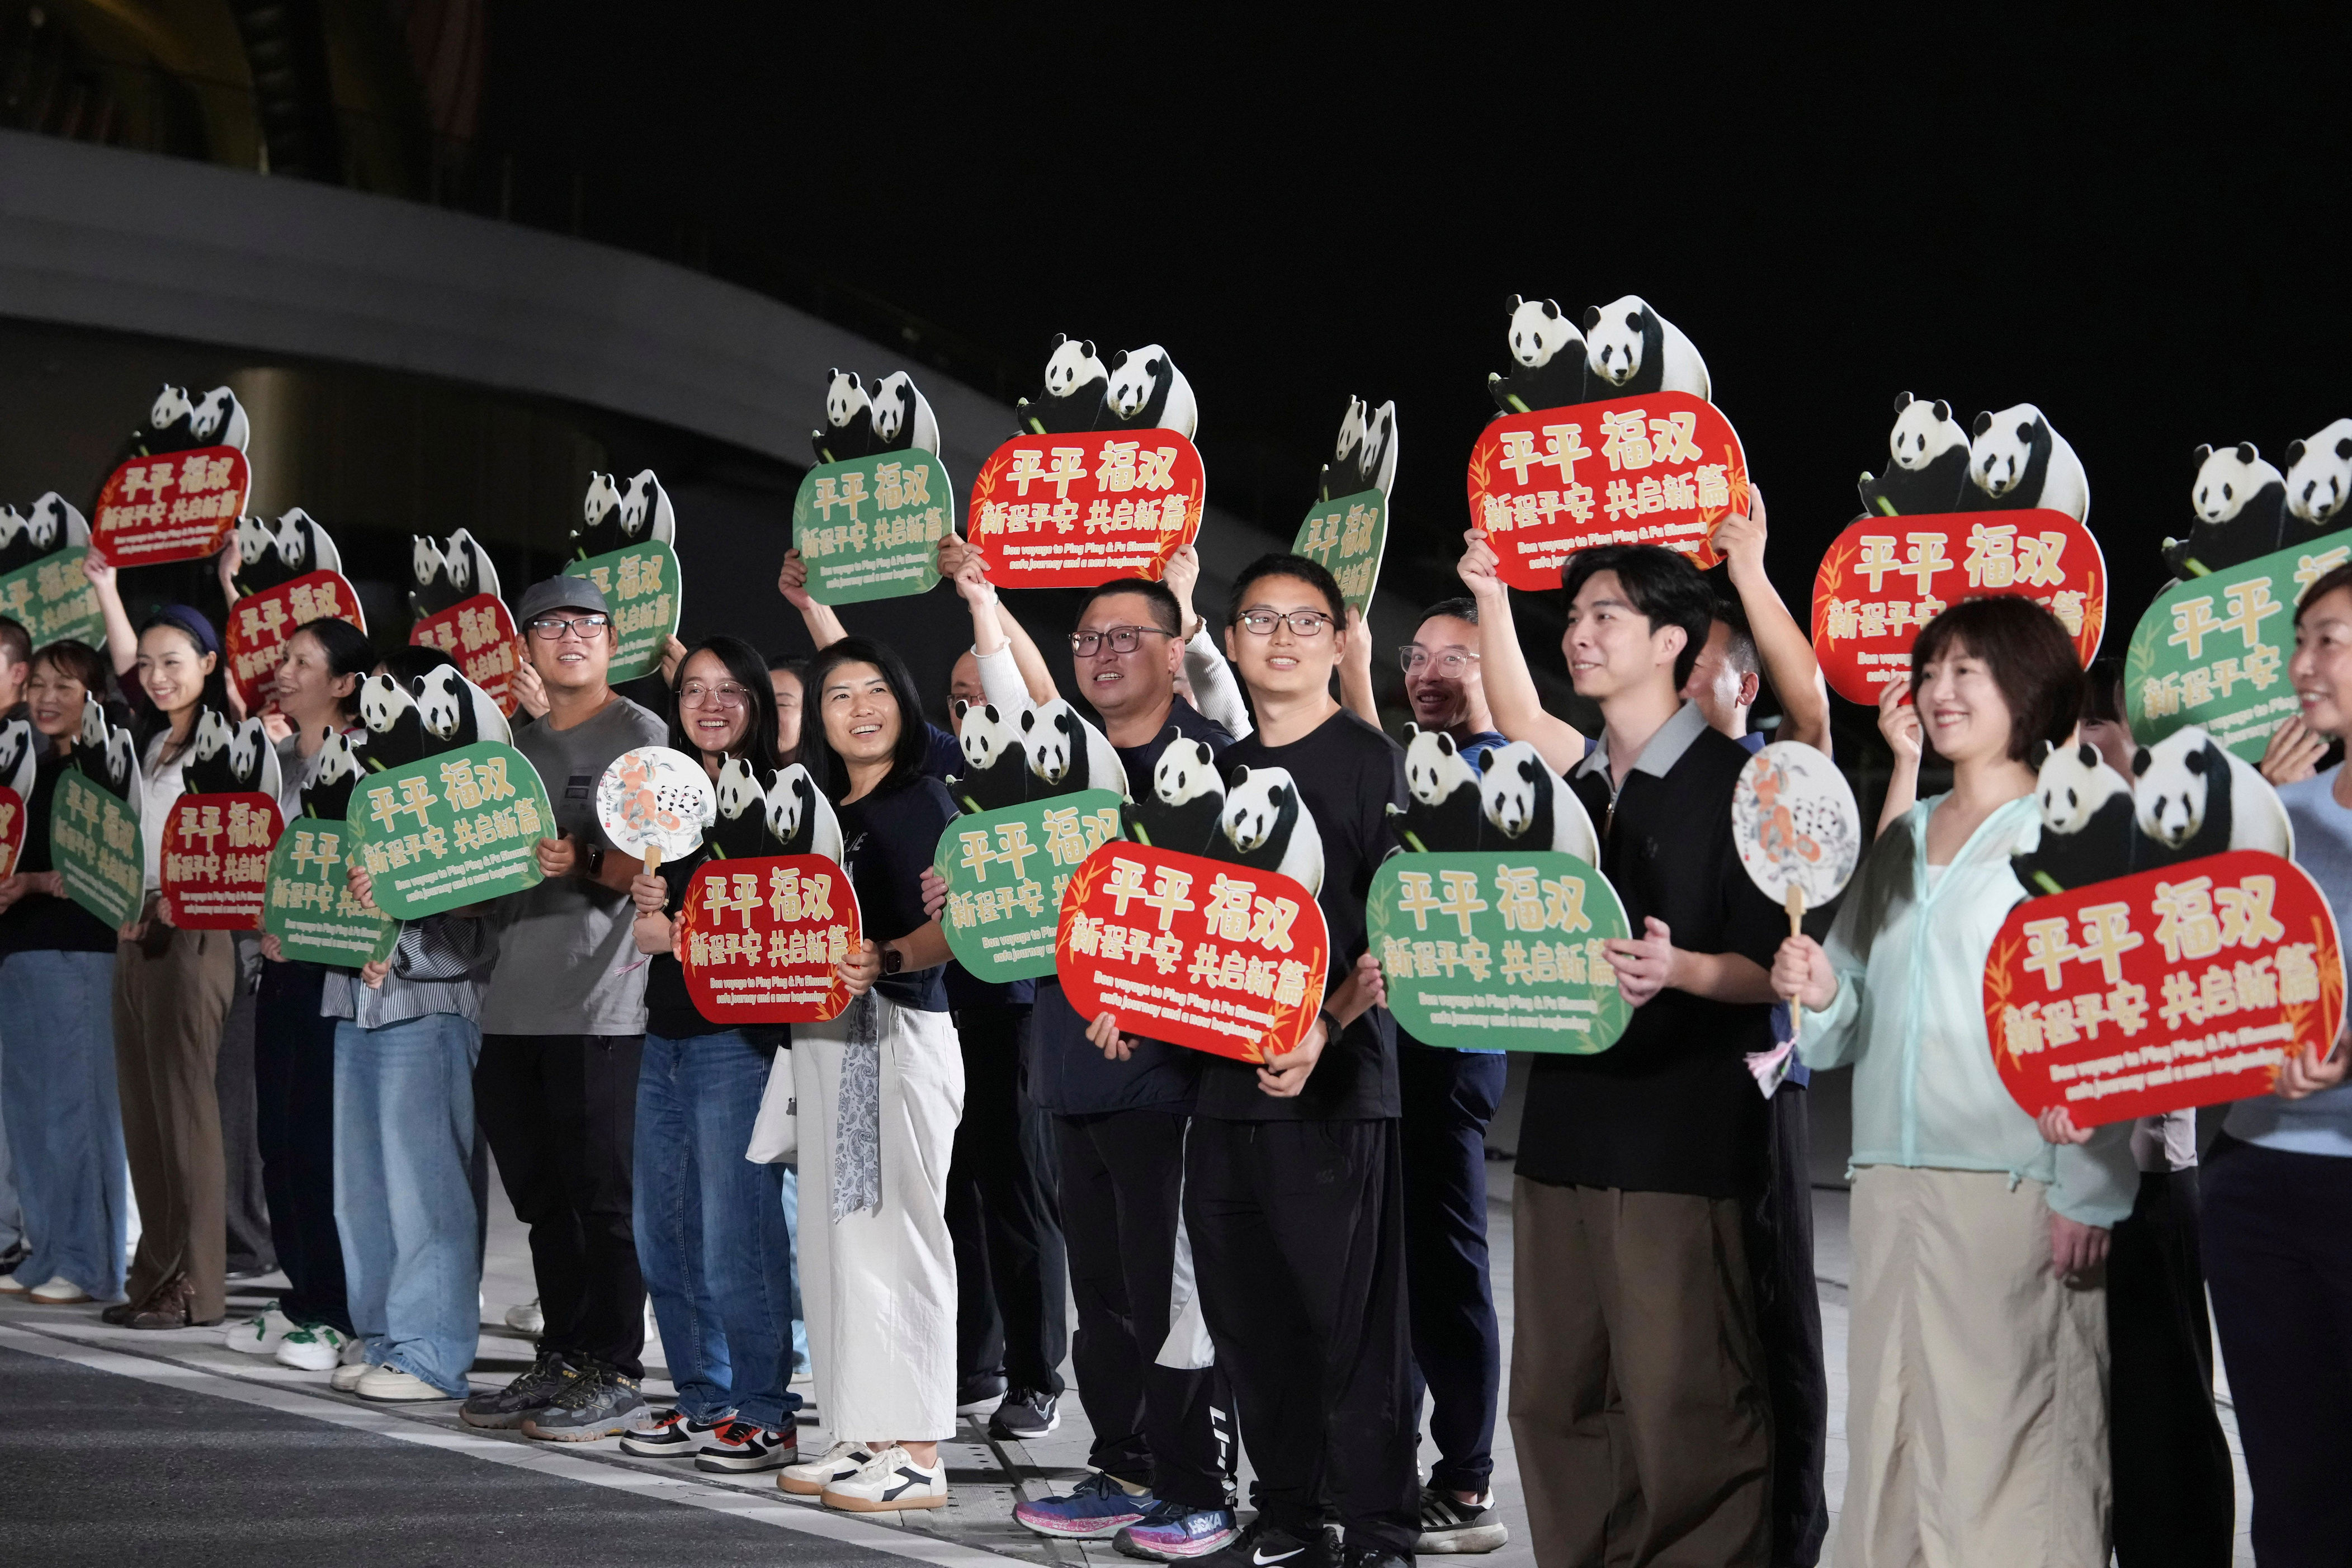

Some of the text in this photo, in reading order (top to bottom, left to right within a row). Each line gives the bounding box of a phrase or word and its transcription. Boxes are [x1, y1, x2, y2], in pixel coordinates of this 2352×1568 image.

[1005, 440, 1178, 499] 平平 福双
[1498, 407, 1703, 486] 平平 福双
[120, 455, 234, 502] 平平 福双
[813, 461, 931, 522] 平平 福双
[1482, 463, 1729, 532] 新程平安 共启新篇
[801, 506, 943, 559] 新程平安 共启新篇
[979, 493, 1189, 535] 新程平安 共启新篇
[1304, 503, 1379, 566] 平平 福双
[1518, 522, 1708, 553] Bon voyage to Ping Ping & Fu Shuang
[1003, 541, 1161, 556] Bon voyage to Ping Ping & Fu Shuang
[1009, 555, 1151, 571] safe journey and a new beginning
[1530, 555, 1554, 568] safe
[1853, 522, 2068, 596] 平平 福双
[616, 554, 664, 601] 福双
[239, 598, 289, 646] 平平
[2167, 576, 2283, 660] 平平
[2143, 643, 2282, 720] 新程平安
[366, 755, 517, 833] 平平 福双
[178, 801, 272, 852] 平平 福双
[363, 824, 448, 875] 新程平安
[452, 796, 542, 854] 共启新篇
[958, 805, 1118, 883] 平平 福双
[290, 830, 341, 880] 平平
[702, 873, 764, 929] 平平
[769, 865, 834, 922] 福双
[949, 877, 1045, 928] 新程平安
[1103, 857, 1195, 930] 平平
[1204, 872, 1301, 953] 福双
[1399, 862, 1593, 937] 平平 福双
[689, 924, 848, 968] 新程平安 共启新篇
[983, 926, 1058, 948] Bon voyage to Pin
[994, 949, 1015, 963] safe
[1012, 945, 1046, 962] journey
[2025, 872, 2285, 990] 平平 福双
[710, 975, 832, 990] Bon voyage to Ping Ping & Fu Shuang
[1071, 911, 1311, 1008] 新程平安 共启新篇
[1385, 935, 1493, 983] 新程平安
[716, 991, 826, 1006] safe journey and a new beginning
[1095, 970, 1276, 1031] Bon voyage to Ping Ping & Fu Shuang
[1101, 991, 1262, 1045] safe journey and a new beginning
[2005, 980, 2149, 1054] 新程平安
[2159, 942, 2321, 1030] 共启新篇
[1188, 1513, 1222, 1535] HOKA
